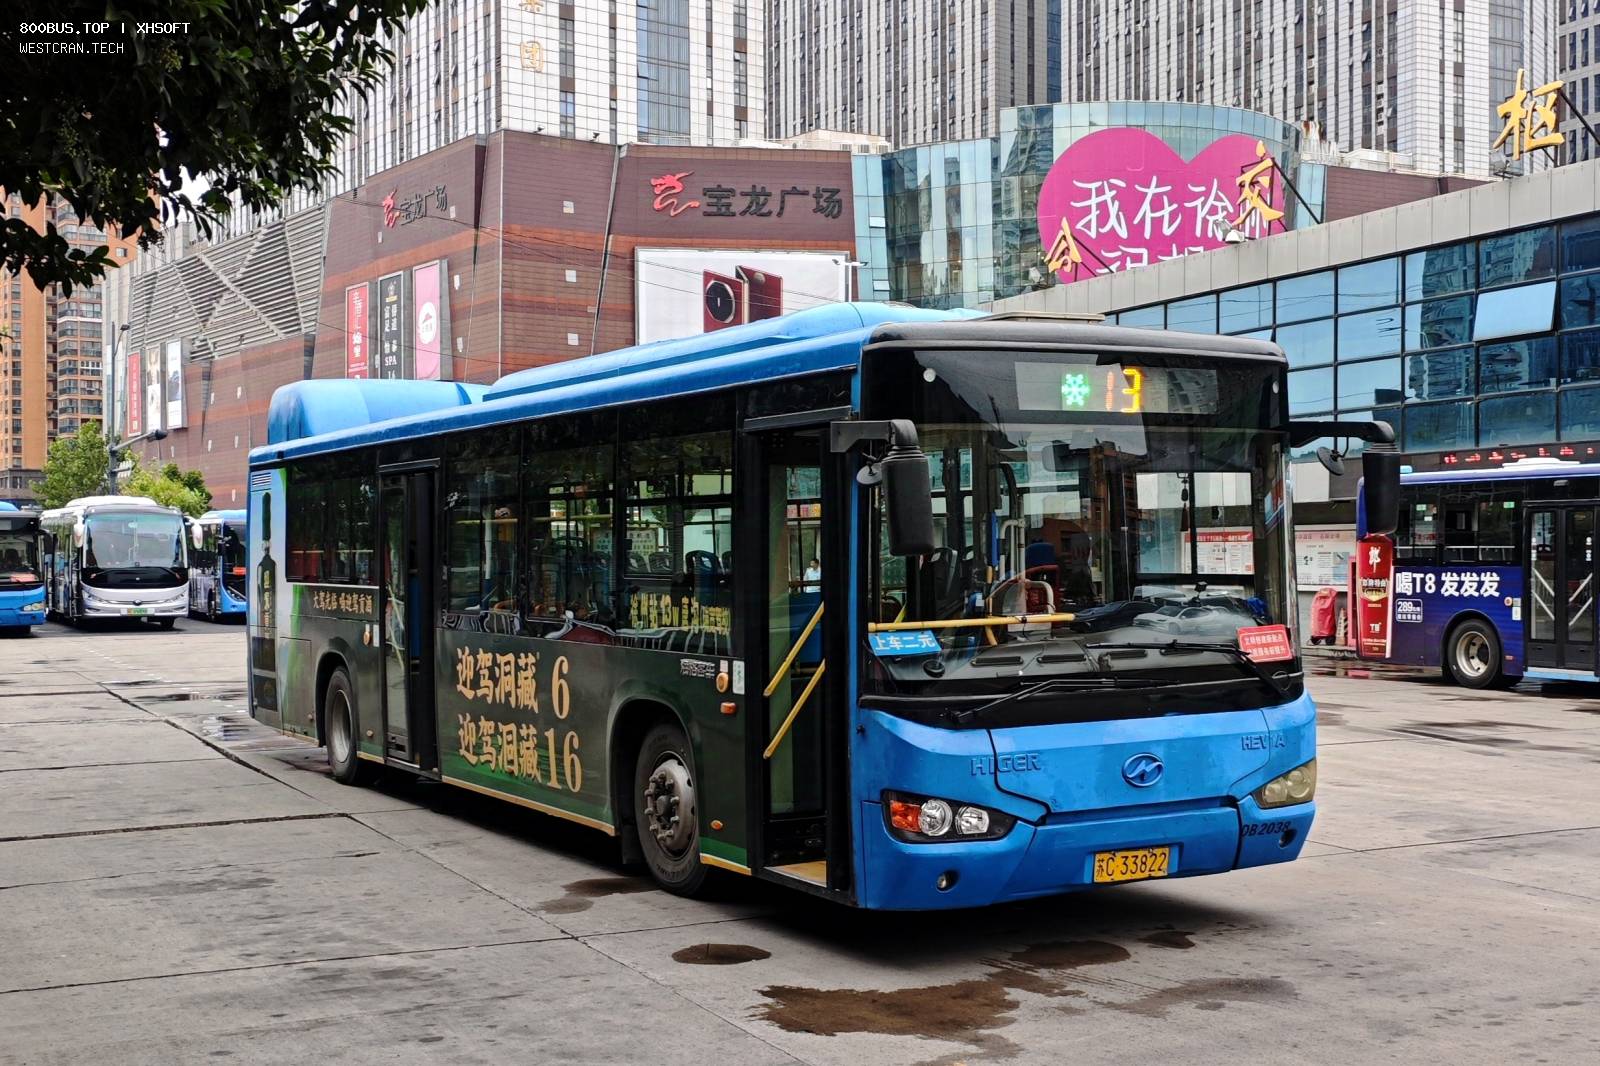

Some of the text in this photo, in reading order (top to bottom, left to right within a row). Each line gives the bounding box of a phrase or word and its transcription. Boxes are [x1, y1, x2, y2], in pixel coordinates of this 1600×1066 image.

[400, 184, 448, 226] 宝龙广场
[702, 184, 844, 219] 宝龙广场
[1105, 368, 1142, 413] 13
[1395, 571, 1500, 597] 喝T8 发发发
[874, 634, 937, 651] 上车二元
[456, 646, 570, 720] 迎驾洞藏 6
[970, 752, 1042, 776] HIGER
